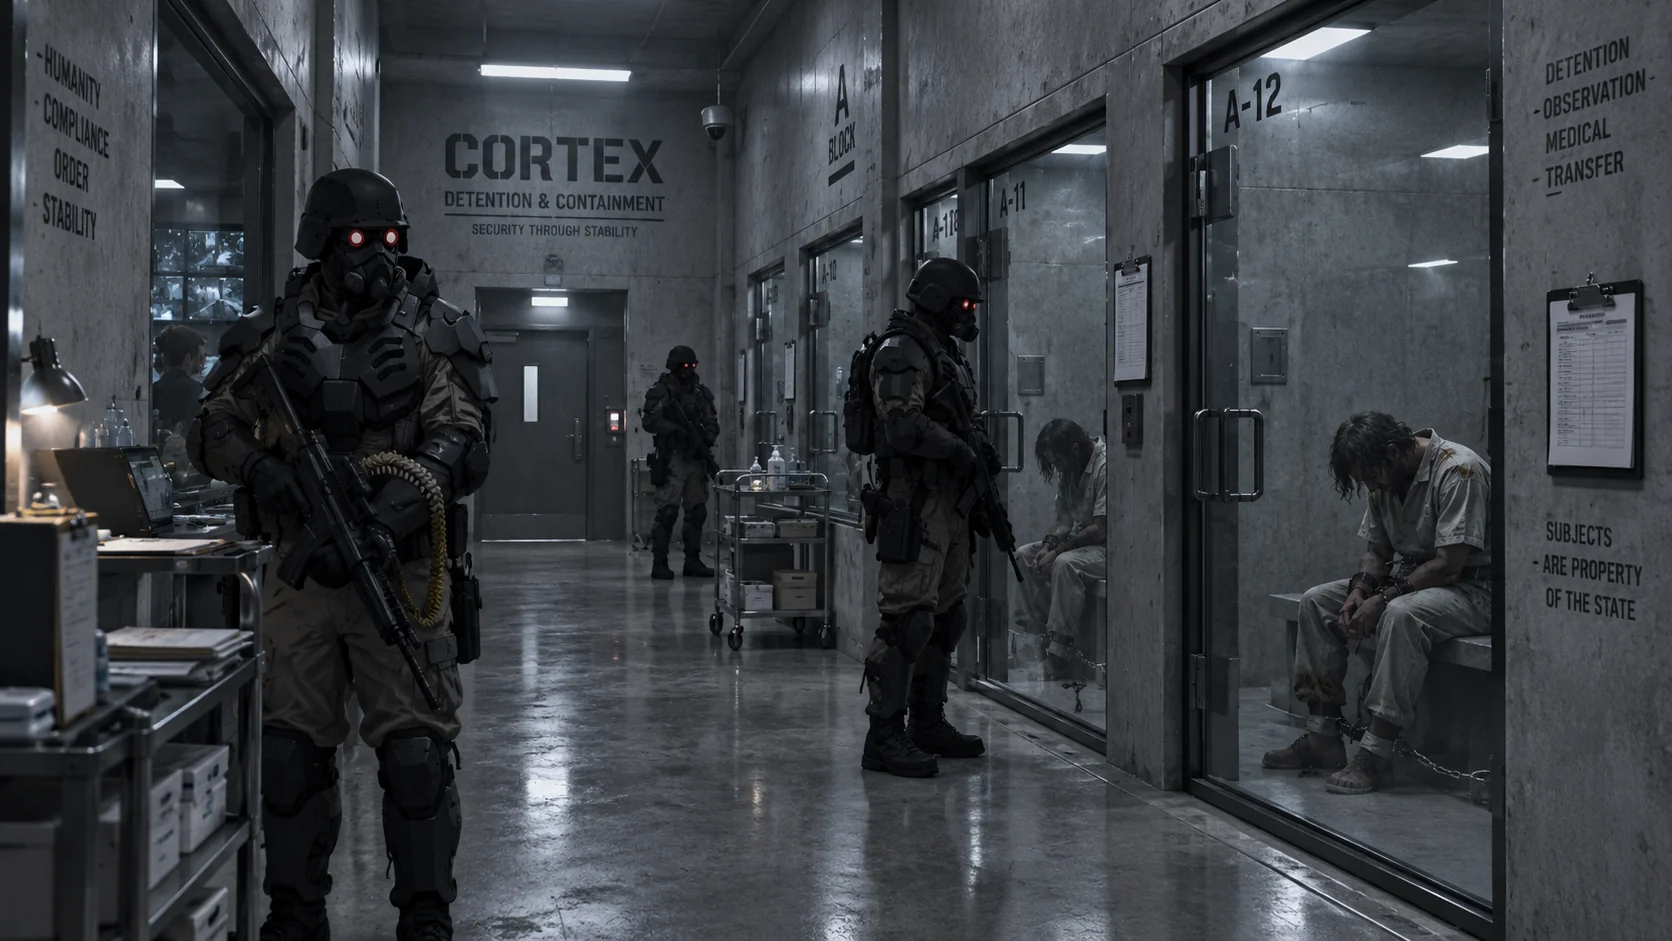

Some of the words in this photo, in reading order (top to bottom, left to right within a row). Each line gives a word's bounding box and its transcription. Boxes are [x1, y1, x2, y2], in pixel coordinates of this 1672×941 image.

[44, 44, 101, 110] HUMANITY
[1546, 36, 1630, 85] DETENTION
[834, 64, 849, 127] A
[1224, 72, 1282, 133] A-12
[1543, 68, 1646, 119] OBSERVATION
[43, 92, 110, 160] COMPLIANCE
[828, 121, 856, 166] BLOCK
[1546, 117, 1611, 154] MEDICAL
[54, 147, 90, 193] ORDER
[445, 133, 664, 184] CORTEX
[1545, 150, 1624, 189] TRANSFER
[42, 193, 97, 241] STABILITY
[444, 191, 532, 209] DETENTION
[538, 192, 550, 210] &
[556, 193, 666, 212] CONTAINMENT
[1000, 180, 1026, 218] A-11
[471, 223, 525, 236] SECURITY
[529, 224, 581, 237] THROUGH
[584, 225, 639, 239] STABILITY
[821, 258, 838, 285] A-10
[1546, 520, 1613, 548] SUBJECTS
[1543, 554, 1568, 576] ARE
[1571, 557, 1643, 587] PROPERTY
[1546, 587, 1562, 609] OF
[1565, 590, 1590, 614] THE
[1594, 594, 1636, 621] STATE
